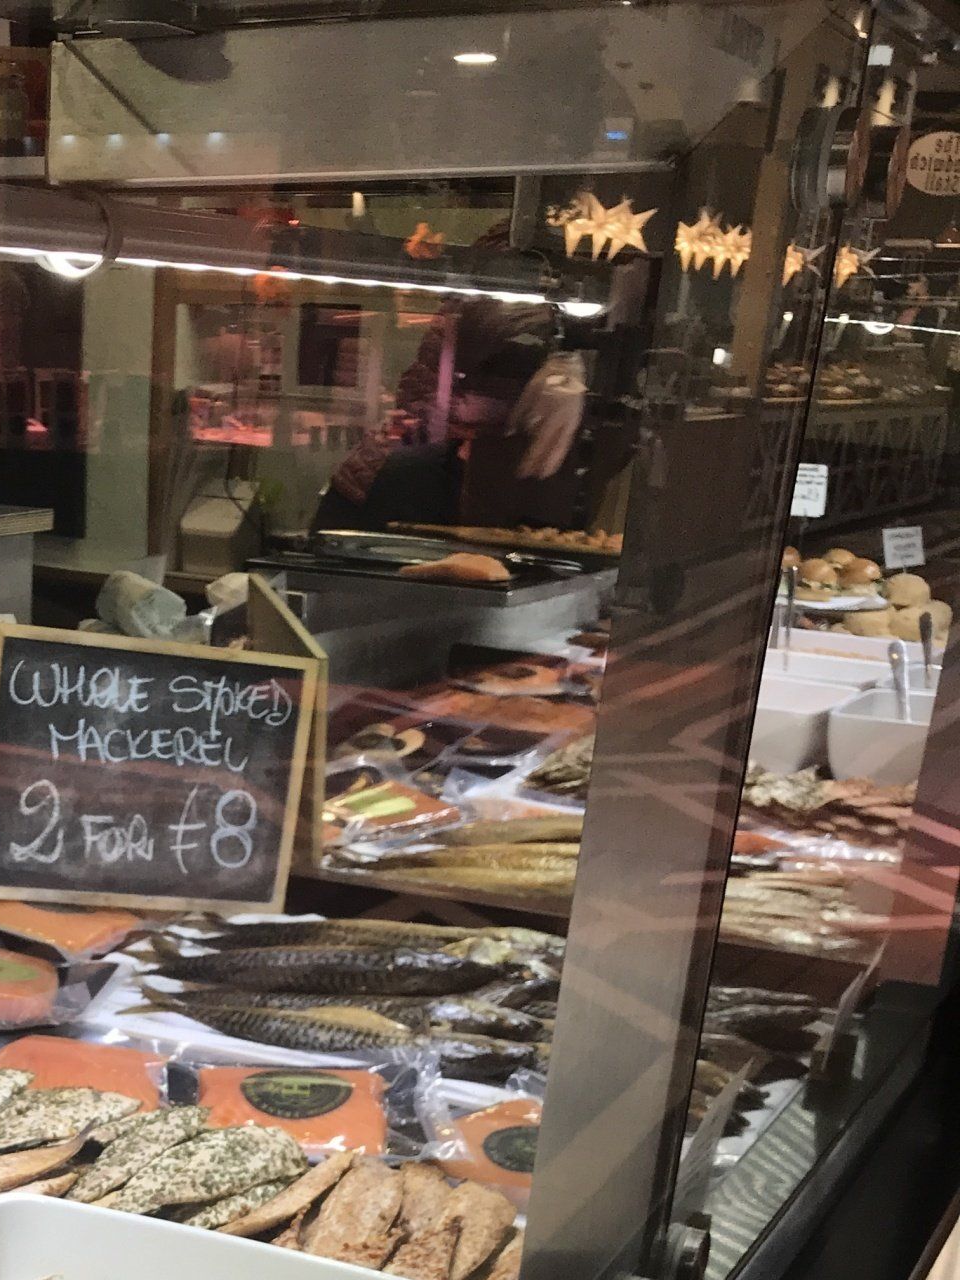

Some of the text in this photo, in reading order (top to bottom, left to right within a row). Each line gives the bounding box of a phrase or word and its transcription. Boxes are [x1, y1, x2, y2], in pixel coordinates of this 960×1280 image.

[9, 660, 155, 713] WHOLE
[49, 718, 249, 773] MACKEREL
[9, 778, 65, 864] 2
[82, 814, 155, 862] FOR
